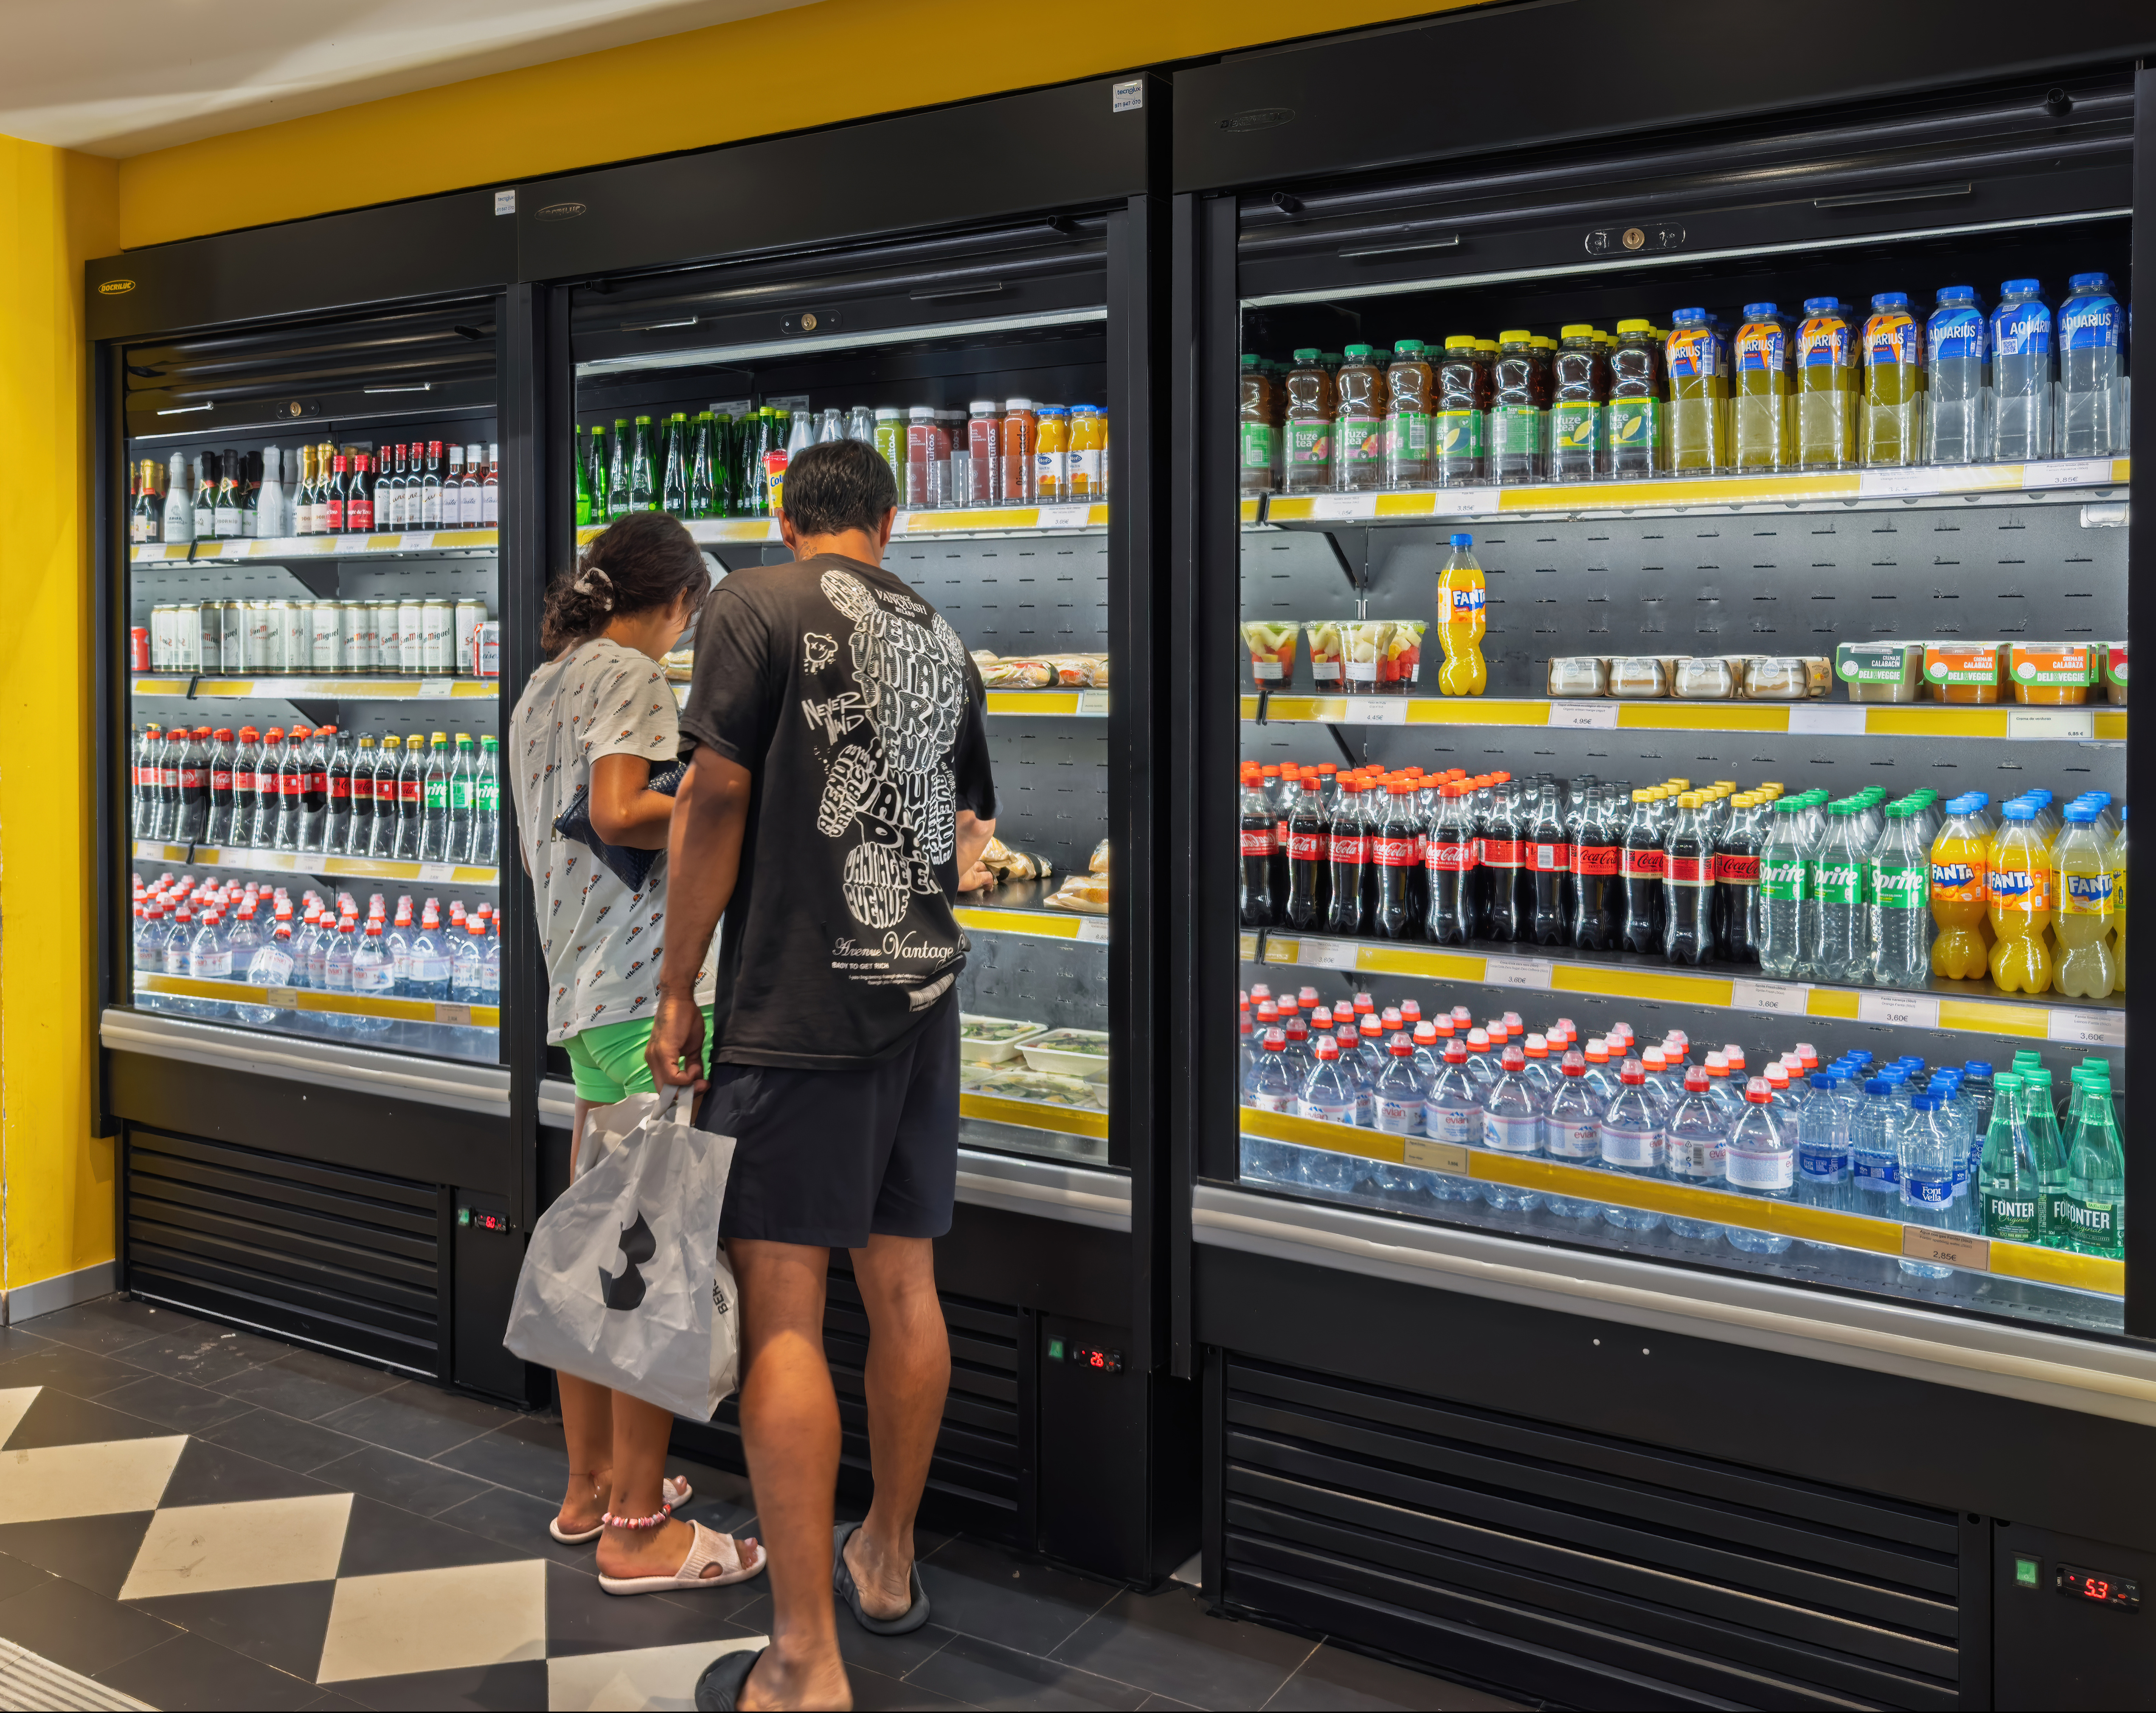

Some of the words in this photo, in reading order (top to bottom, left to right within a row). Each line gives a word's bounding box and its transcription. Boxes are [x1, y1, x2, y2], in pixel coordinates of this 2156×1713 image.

[1117, 86, 1141, 95] tecnolux
[101, 282, 131, 292] DOCRILUC
[2061, 312, 2112, 331] AQUARIUS
[1929, 325, 1976, 340] AQUARIUS
[1798, 334, 1842, 350] AQUARIUS
[1557, 415, 1581, 425] fuze
[1610, 412, 1629, 423] fuze
[1437, 425, 1449, 434] uze
[1557, 423, 1575, 432] tea
[1610, 421, 1624, 430] tea
[1296, 432, 1318, 442] fuze
[1345, 429, 1367, 439] fuze
[1296, 439, 1313, 447] tea
[1346, 436, 1362, 445] tea
[874, 588, 928, 615] VANQUISH
[1872, 659, 1900, 667] CALABACÍN
[1858, 670, 1900, 680] DELI&VEGGIE
[1948, 672, 1993, 681] DELI&VEGGIE
[2037, 672, 2085, 682] DELI&VEGGIE
[1373, 840, 1408, 856] Coca-Cola
[1426, 844, 1464, 861] Coca-Cola
[1932, 864, 1974, 881] FANTA
[1871, 869, 1923, 892] Sprite
[1991, 870, 2034, 889] FANTA
[2069, 875, 2113, 894] FANTA
[883, 931, 954, 962] Vantage
[625, 962, 644, 979] ellesse
[630, 997, 648, 1013] ellesse
[1758, 1000, 1779, 1009] 3,60€
[1886, 1014, 1909, 1022] 3,60€
[2080, 1032, 2104, 1041] 3,60€
[1382, 1108, 1407, 1117] evian
[1446, 1116, 1469, 1125] evian
[1574, 1130, 1598, 1139] evian
[1709, 1148, 1726, 1159] evia
[1922, 1186, 1941, 1195] Font
[1922, 1193, 1942, 1202] Vella
[1992, 1197, 2035, 1218] FONTER
[1999, 1215, 2030, 1226] Original
[2067, 1203, 2110, 1229] FONTER
[1933, 1251, 1957, 1261] 2,85€
